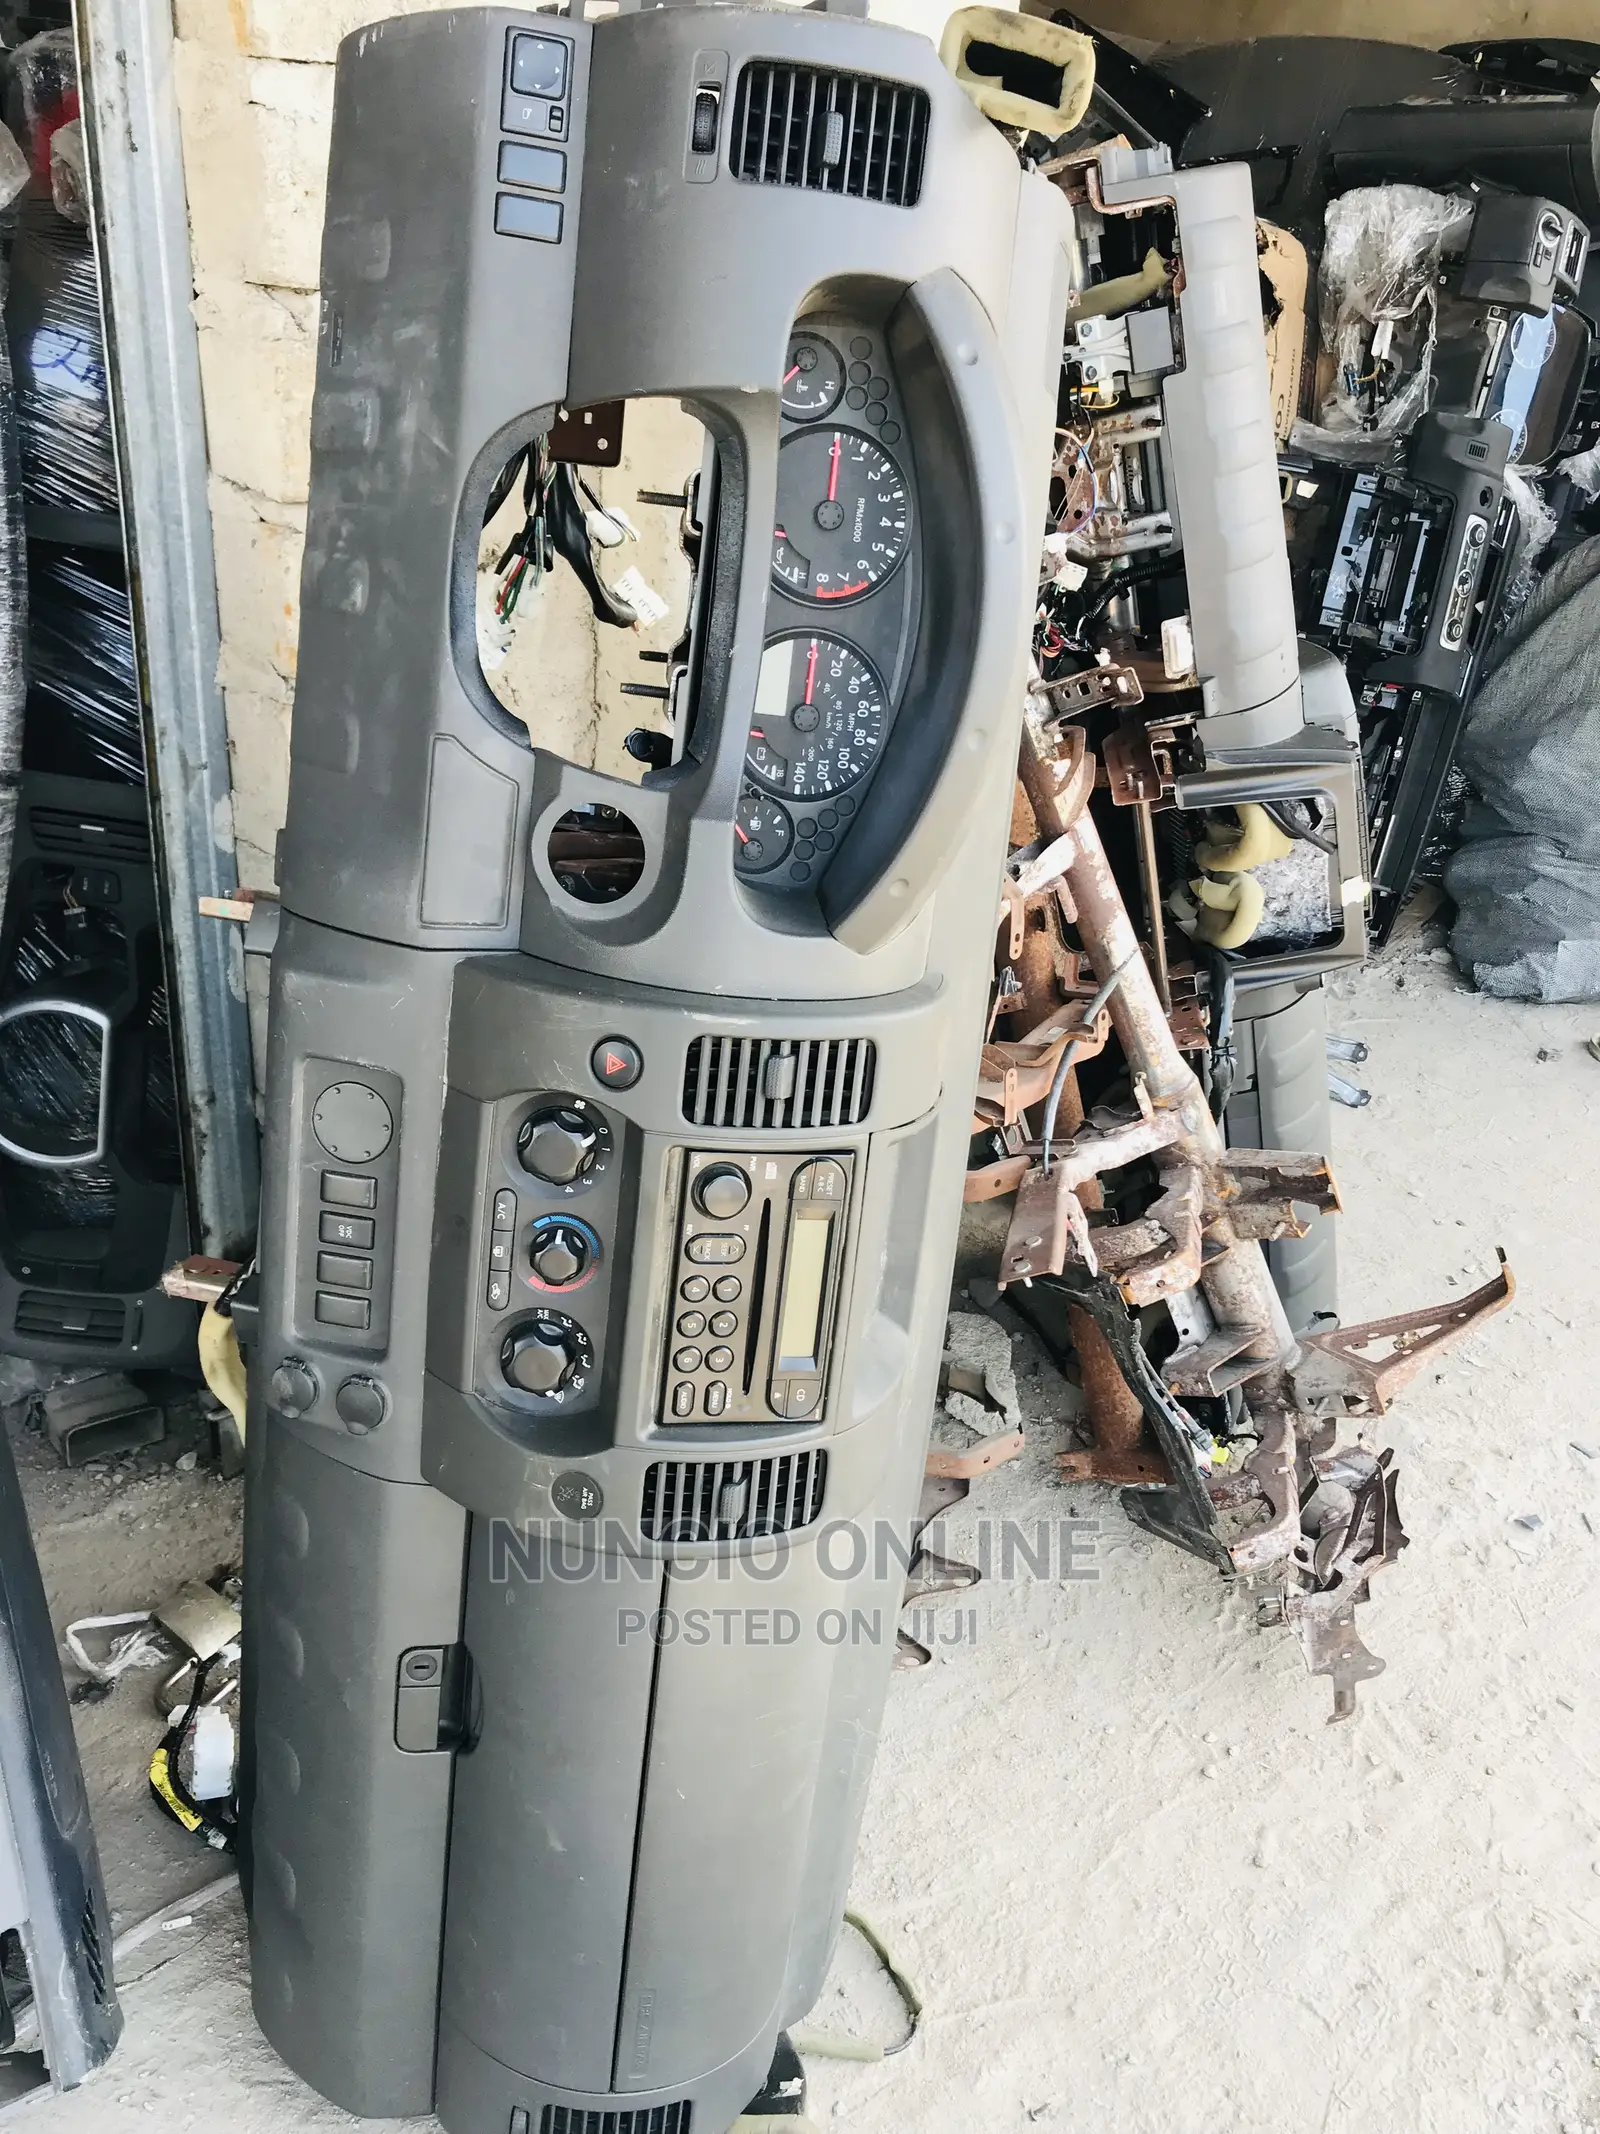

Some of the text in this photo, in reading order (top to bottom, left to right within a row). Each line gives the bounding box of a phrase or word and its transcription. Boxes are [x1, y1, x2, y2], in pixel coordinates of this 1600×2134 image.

[825, 380, 834, 390] H
[828, 446, 841, 456] 0
[868, 471, 880, 480] 2
[878, 494, 890, 502] 3
[853, 498, 865, 542] RPMx1000
[880, 517, 892, 527] 4
[872, 542, 884, 552] 5
[857, 560, 869, 570] 6
[816, 573, 829, 582] 8
[837, 572, 849, 582] 7
[830, 660, 842, 677] 20
[824, 682, 831, 692] 40
[848, 676, 860, 694] 40
[836, 701, 842, 710] 80
[857, 700, 868, 718] 60
[847, 712, 856, 732] MPH
[854, 728, 866, 746] 80
[837, 748, 850, 770] 100
[776, 769, 784, 778] 18
[794, 762, 806, 783] 140
[816, 760, 830, 780] 120
[826, 1172, 834, 1196] PRESET
[497, 1202, 506, 1220] A/C
[704, 1240, 712, 1260] TRACK
[680, 1391, 688, 1409] AUDIO
[711, 1390, 720, 1408] MENU
[796, 1388, 806, 1402] CD
